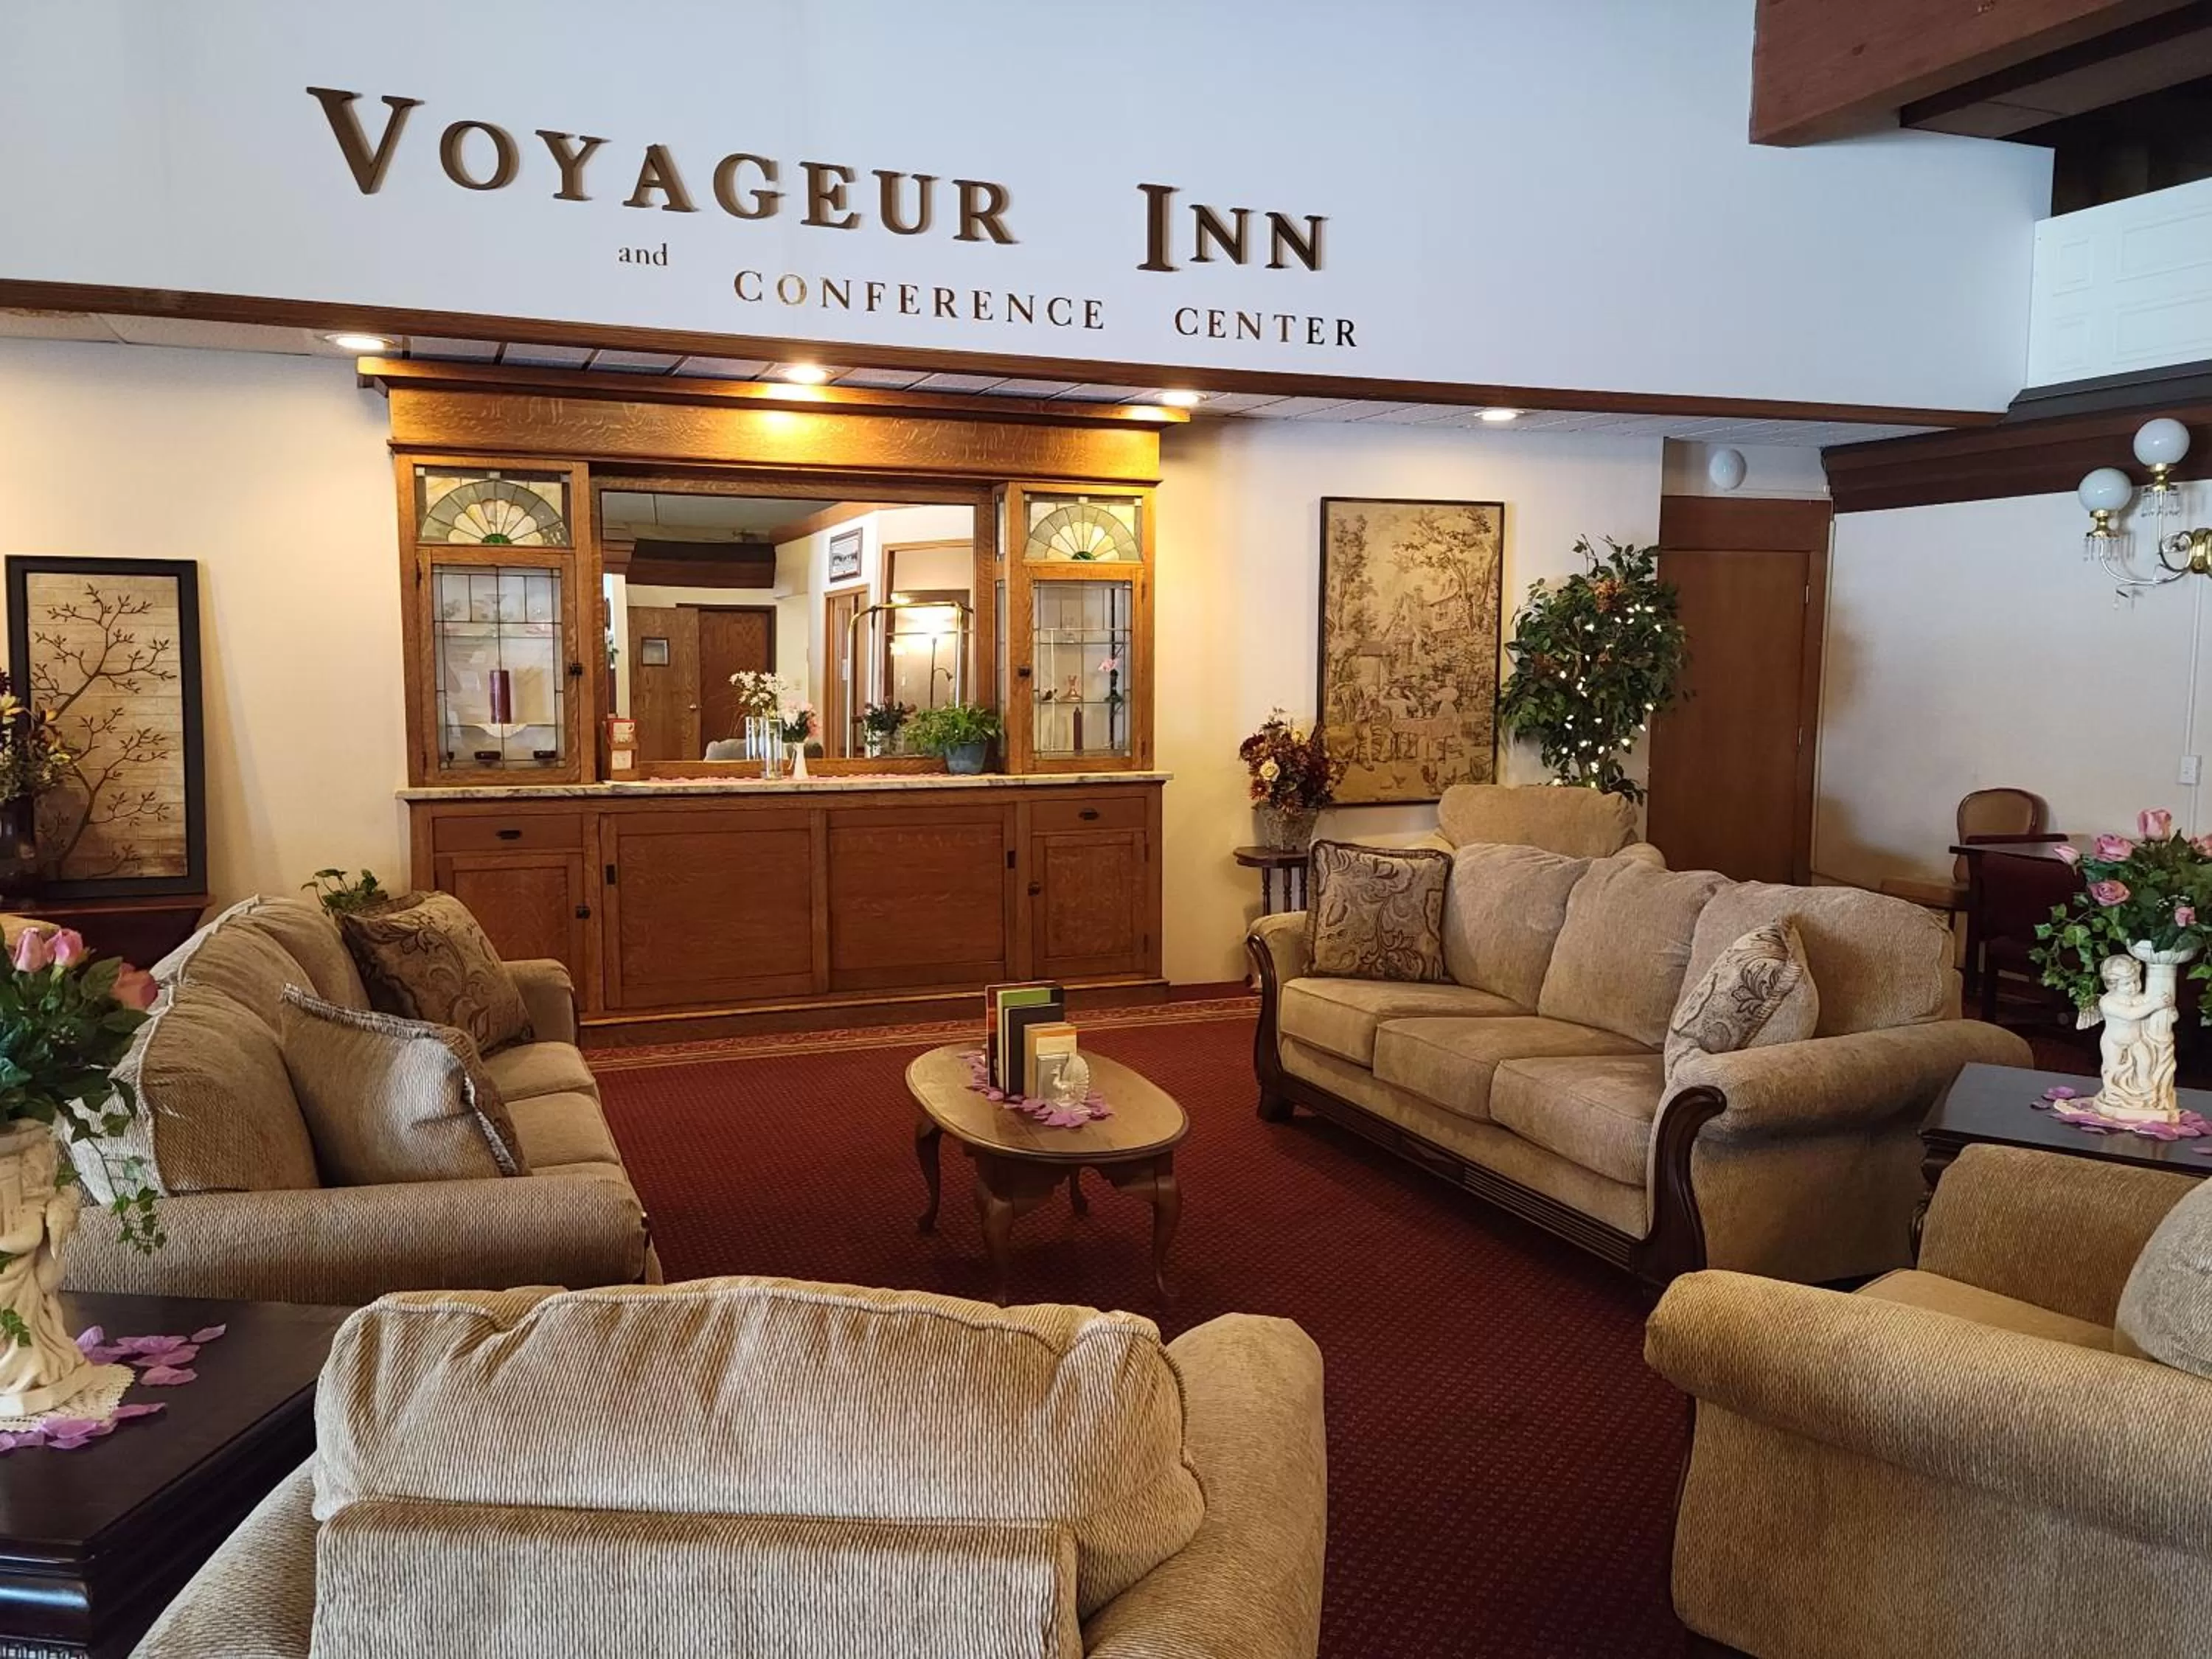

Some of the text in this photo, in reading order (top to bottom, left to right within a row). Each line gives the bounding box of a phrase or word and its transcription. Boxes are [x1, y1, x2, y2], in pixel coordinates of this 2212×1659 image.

[306, 86, 1329, 272] VOYAGEUR INN
[618, 243, 668, 266] and
[734, 271, 1357, 347] CONFERENCE CENTER
